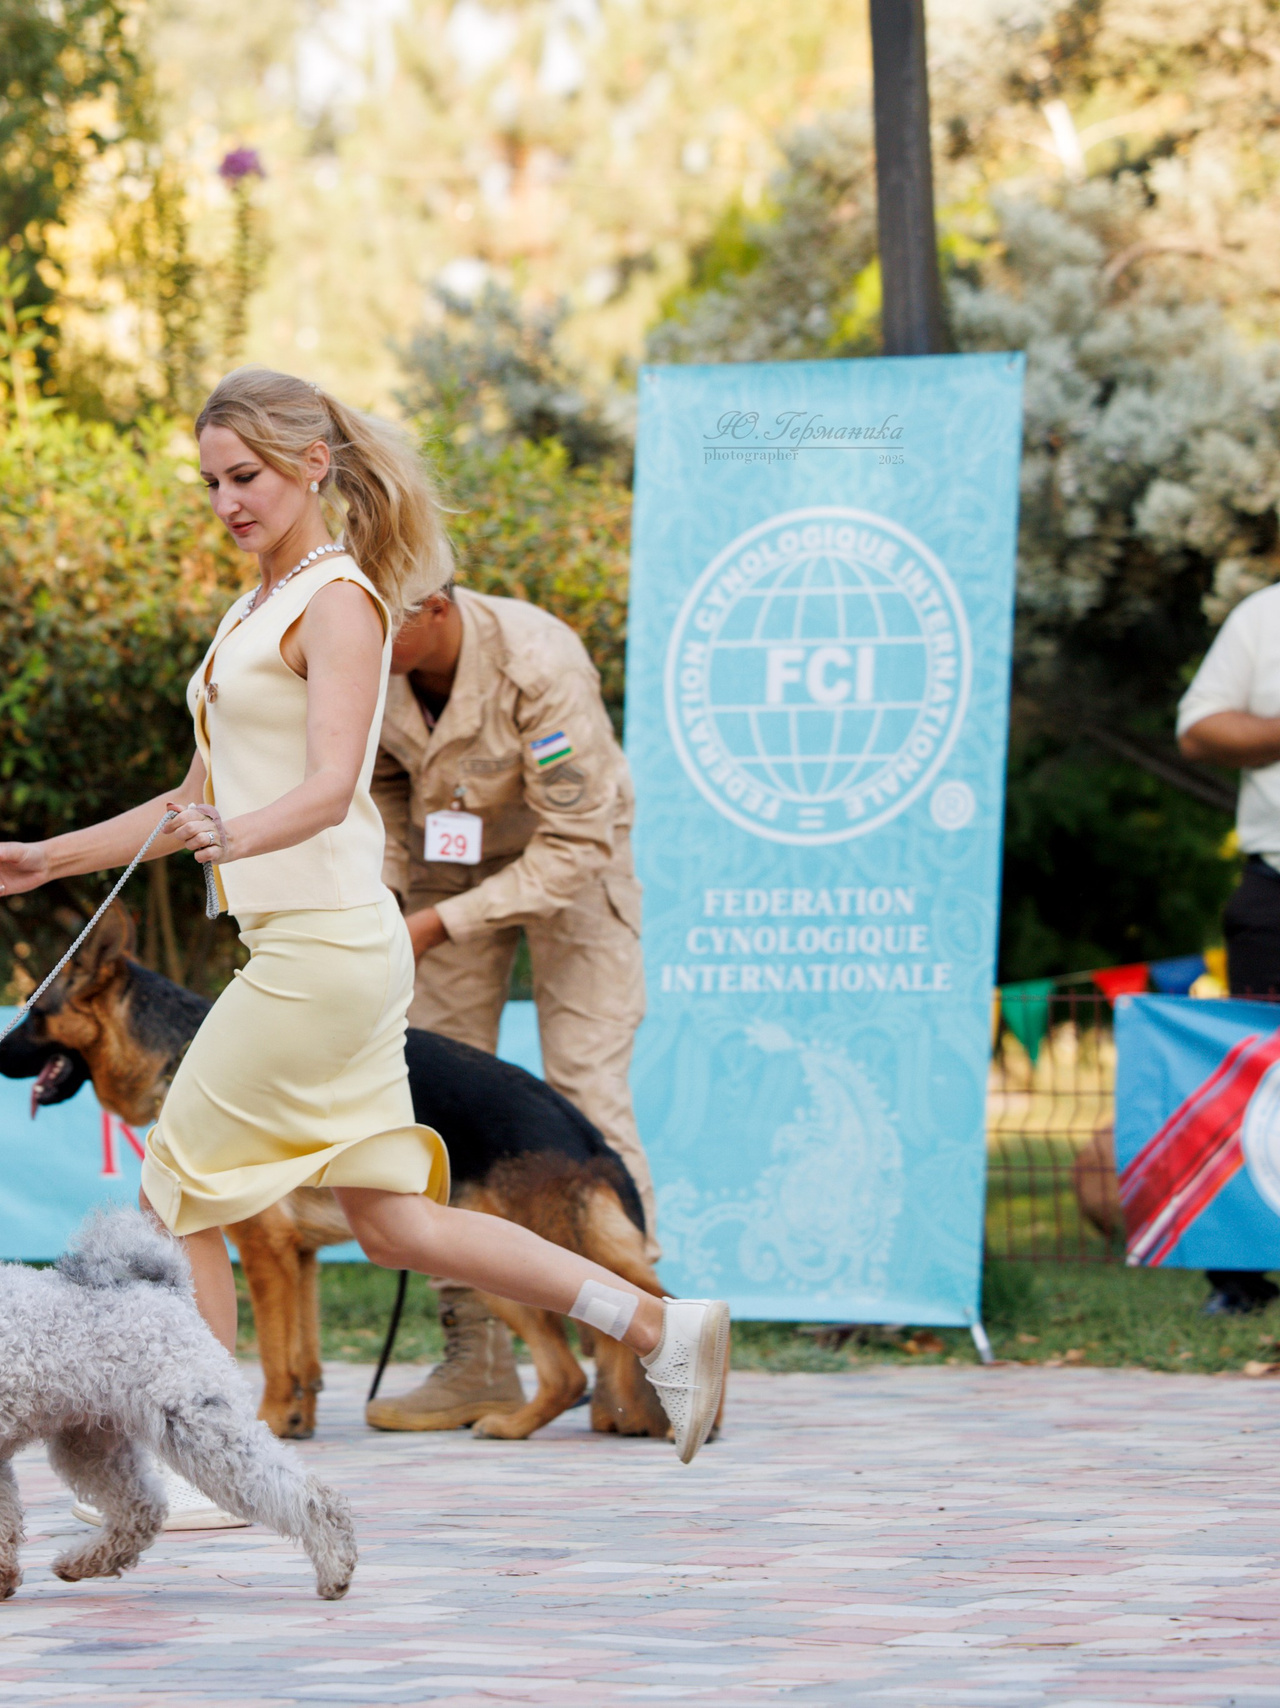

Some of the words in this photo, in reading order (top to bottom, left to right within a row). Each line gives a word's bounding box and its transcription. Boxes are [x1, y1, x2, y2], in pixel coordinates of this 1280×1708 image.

[695, 526, 899, 630] CYNOLOGIQUE
[766, 646, 875, 705] FCI
[845, 559, 957, 819] INTERNATIONALE
[682, 641, 782, 821] FEDERATION
[439, 833, 467, 857] 29
[703, 888, 916, 917] FEDERATION
[687, 926, 928, 955] CYNOLOGIQUE
[661, 964, 951, 993] INTERNATIONALE
